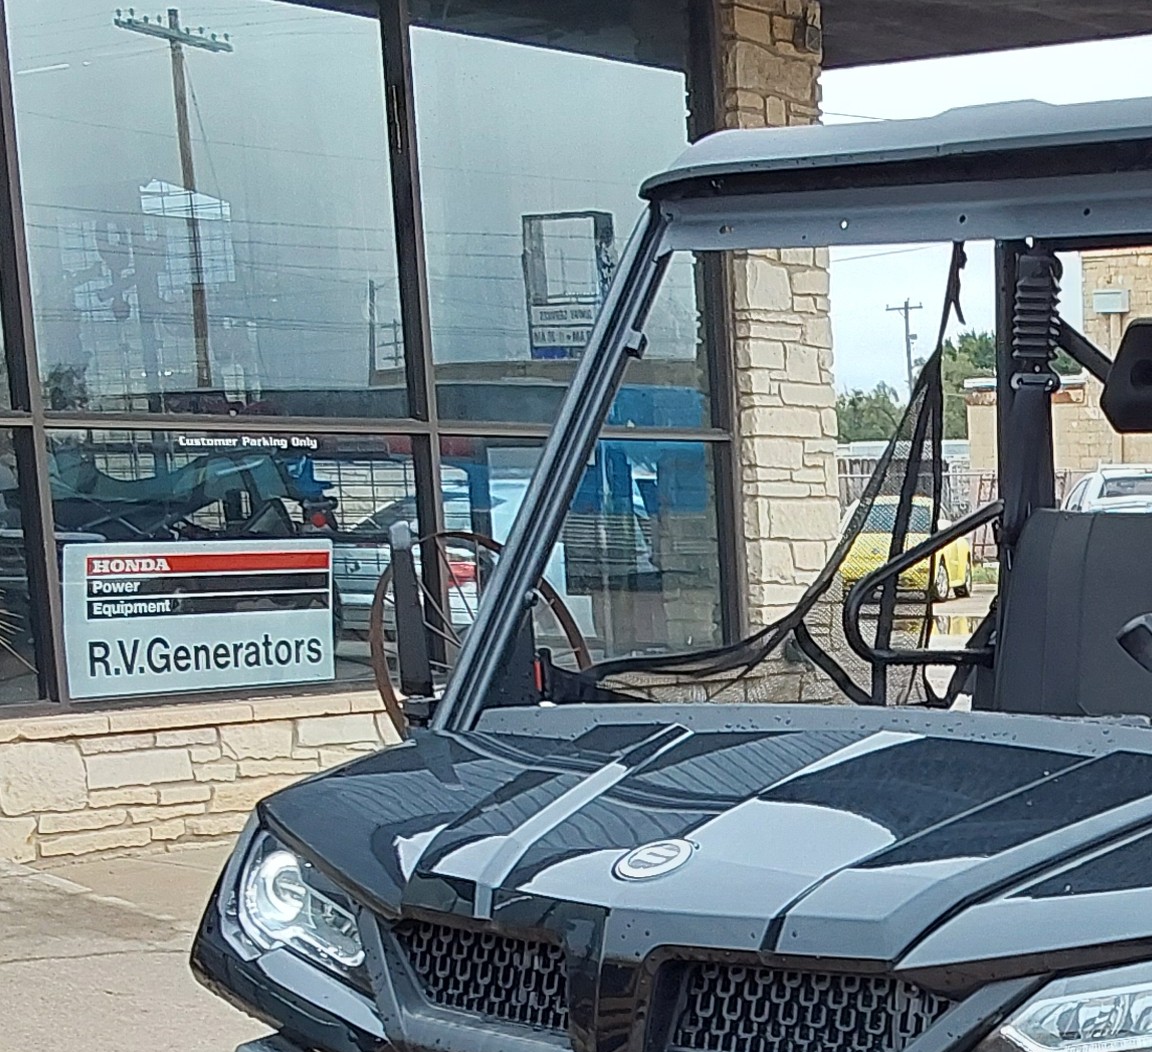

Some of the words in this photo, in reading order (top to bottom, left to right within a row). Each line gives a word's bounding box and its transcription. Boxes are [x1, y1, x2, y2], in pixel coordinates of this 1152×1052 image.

[178, 435, 238, 447] Customer
[241, 436, 288, 449] Parking
[290, 436, 318, 449] Only
[91, 558, 171, 573] HONDA
[92, 579, 141, 594] Power
[92, 600, 171, 616] Equipment
